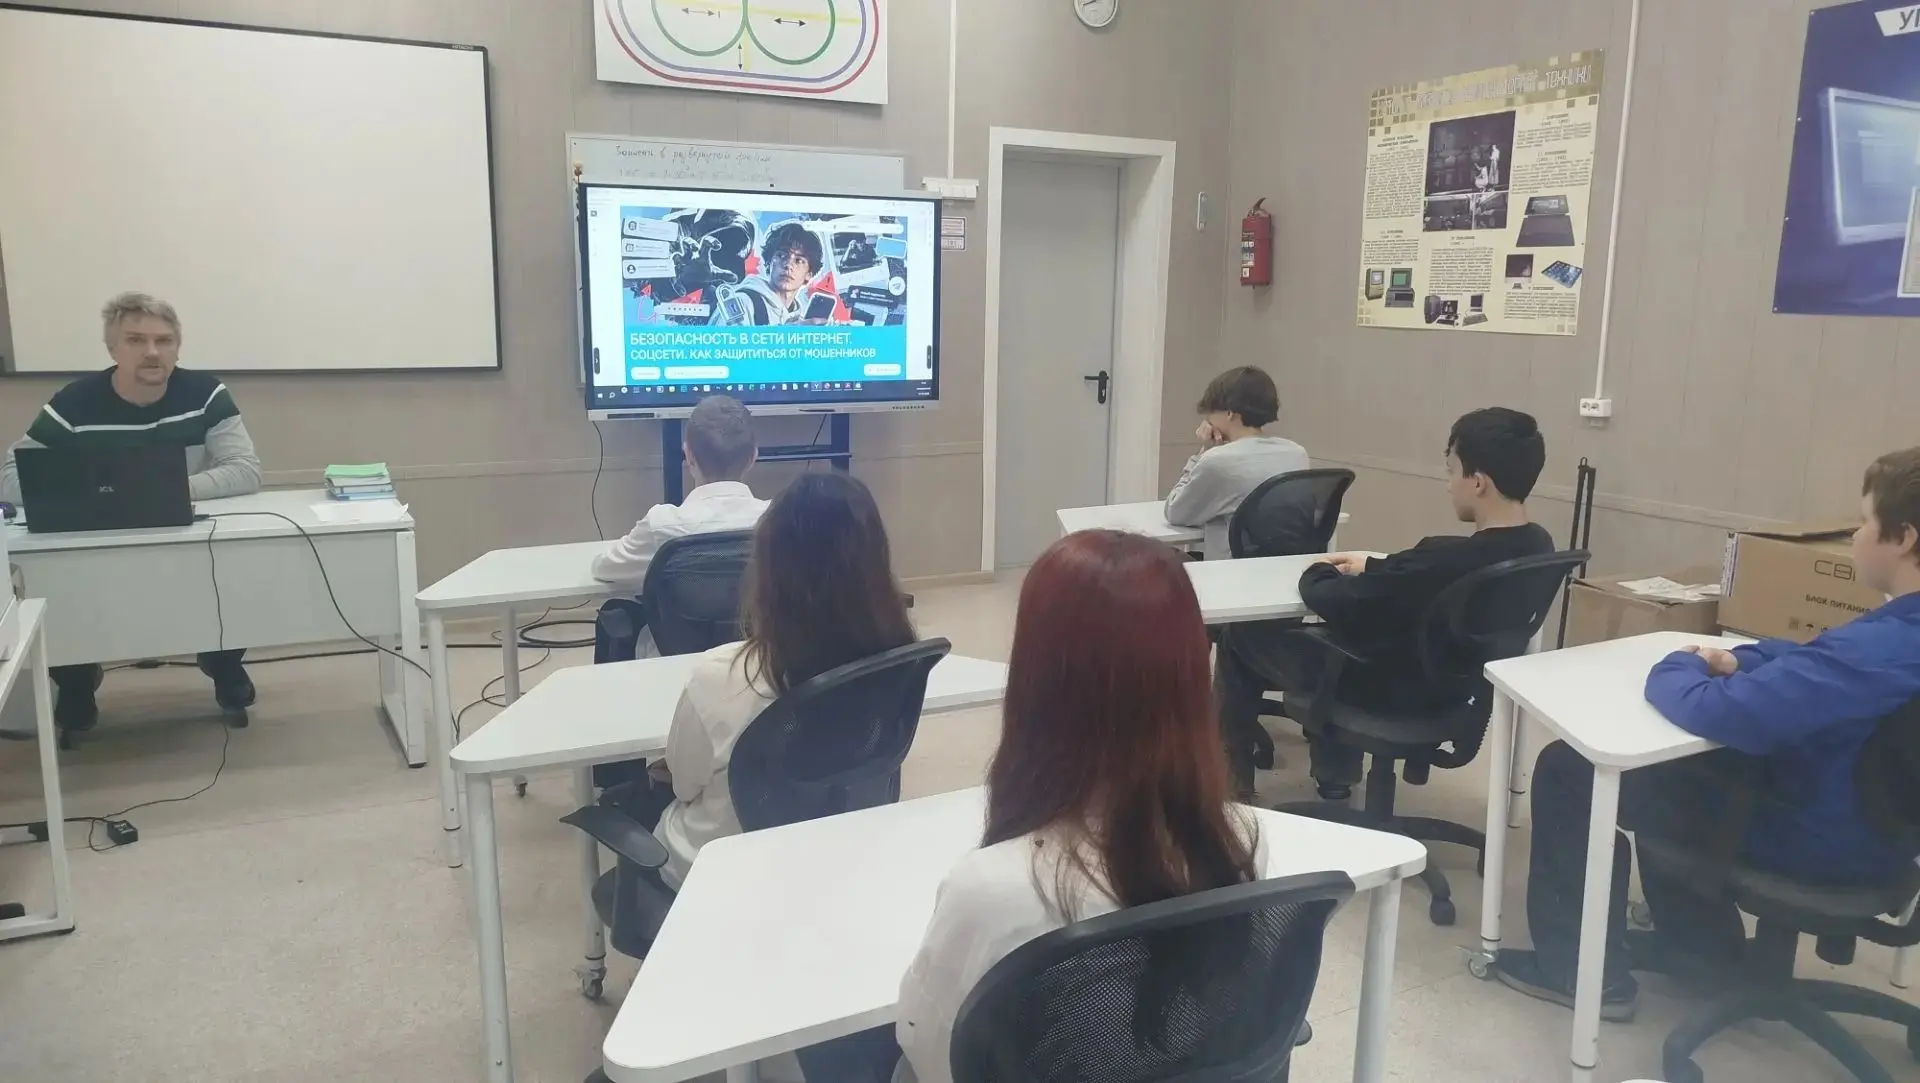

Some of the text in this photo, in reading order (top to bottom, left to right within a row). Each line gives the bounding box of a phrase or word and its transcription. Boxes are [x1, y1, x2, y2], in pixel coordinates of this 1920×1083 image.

[630, 332, 852, 346] БЕЗОПАСНОСТЬ В СЕТИ ИНТЕРНЕТ.
[630, 347, 877, 361] СОЦСЕТИ. КАК ЗАЩИТИТЬСЯ ОТ МОШЕННИКОВ
[1814, 559, 1856, 582] CB
[1805, 594, 1828, 606] БЛОК
